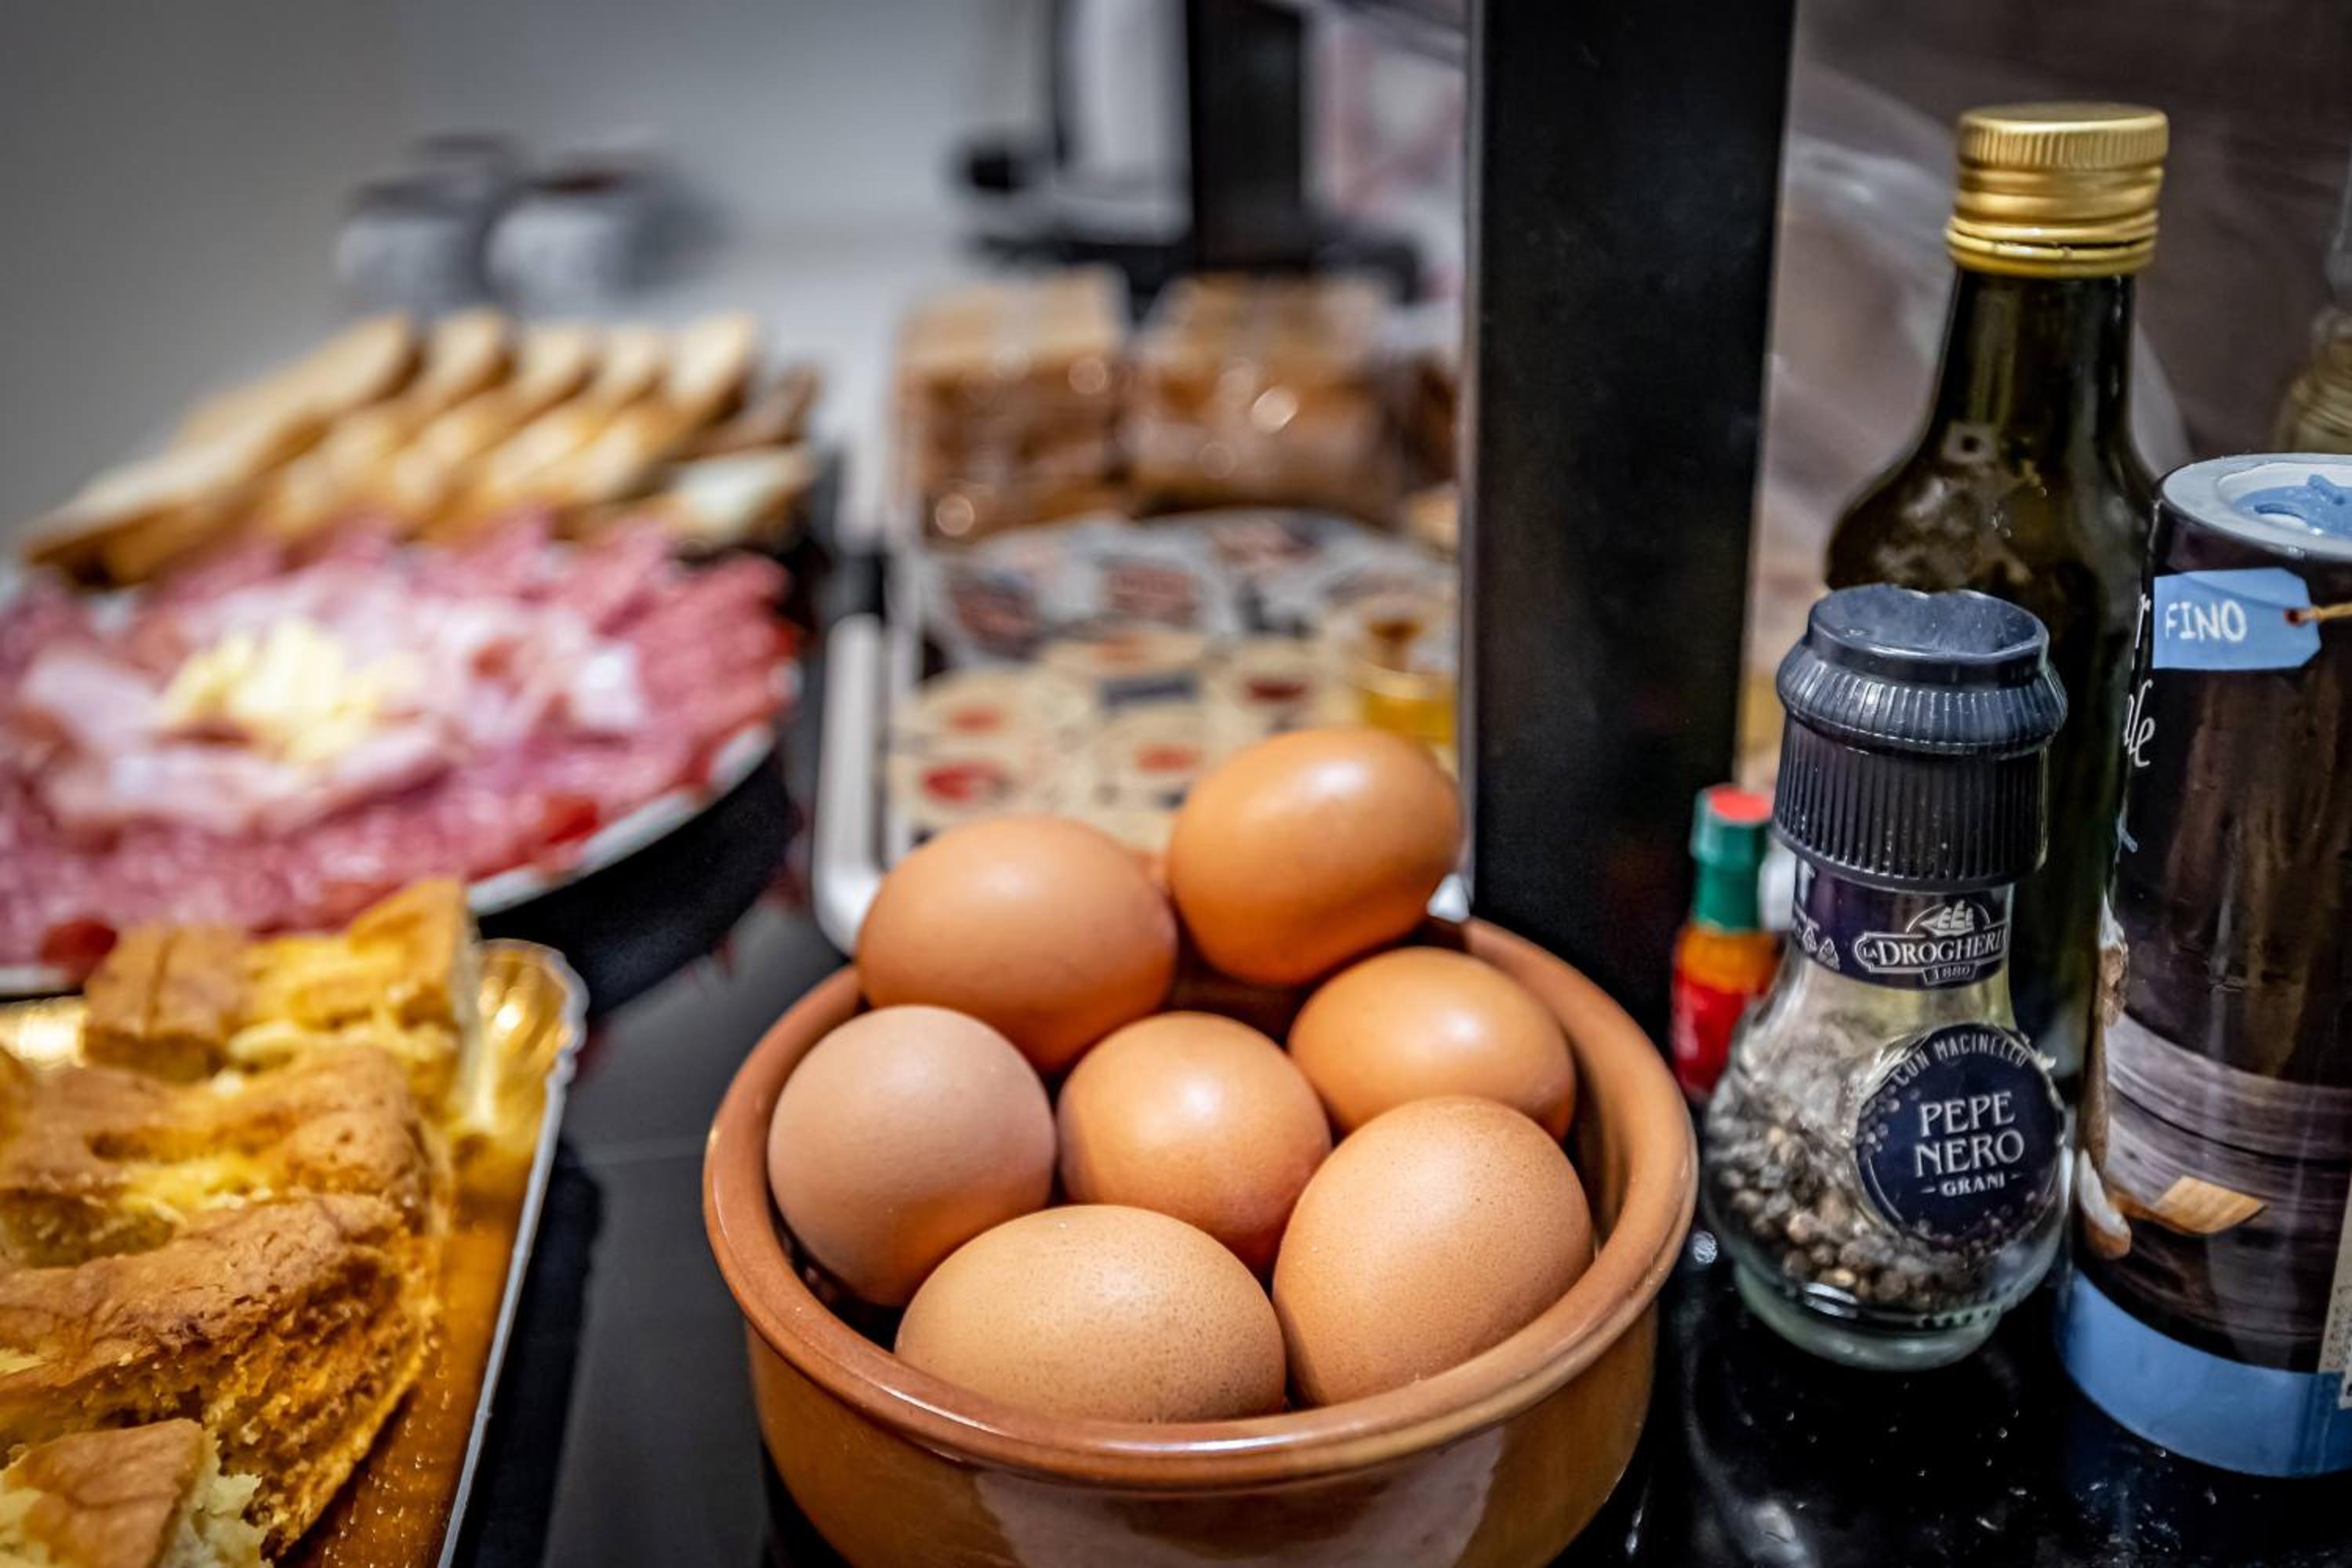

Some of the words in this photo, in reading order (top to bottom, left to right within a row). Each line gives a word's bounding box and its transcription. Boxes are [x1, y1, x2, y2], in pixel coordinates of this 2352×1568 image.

[2165, 601, 2247, 643] FINO
[1893, 1049, 1931, 1086] CON
[1933, 1033, 2029, 1067] MACINELLO
[1920, 1091, 2016, 1138] PEPE
[1914, 1128, 2025, 1178] NERO
[1940, 1171, 2005, 1197] GRANI
